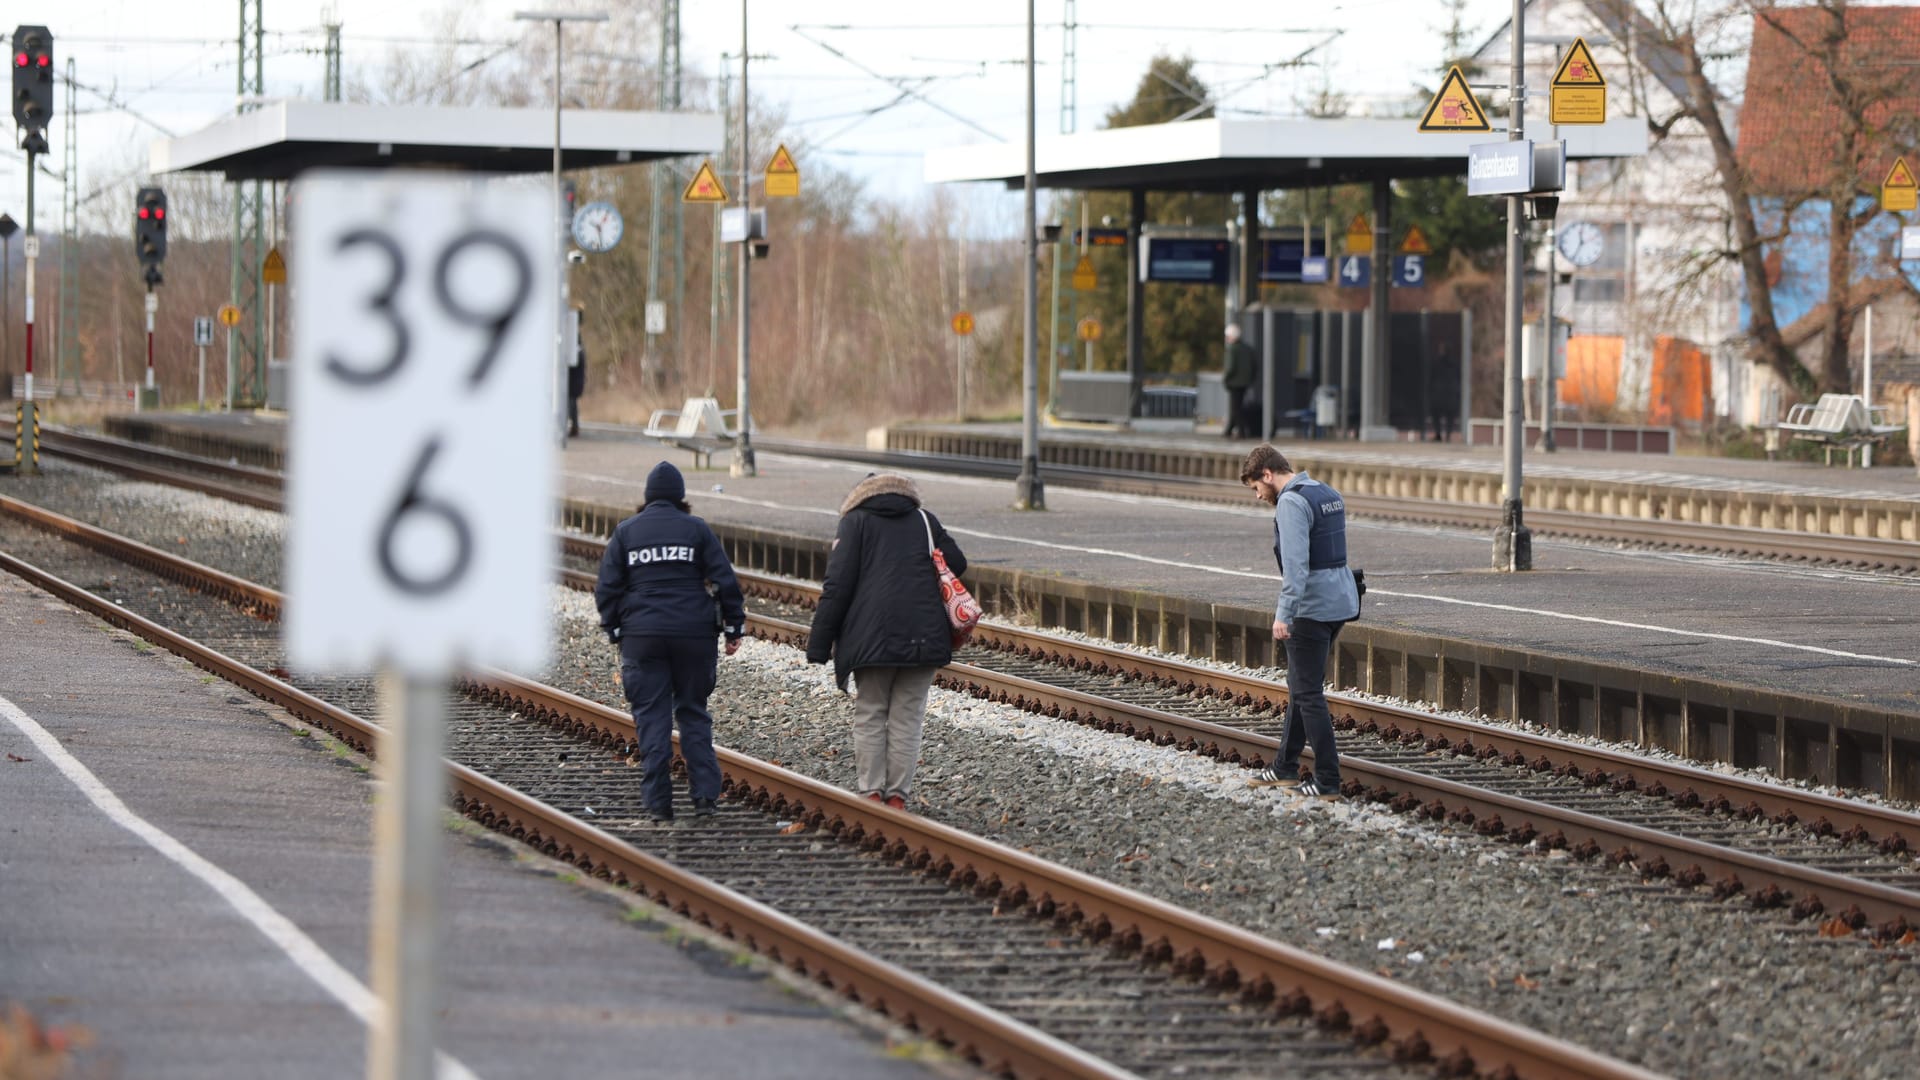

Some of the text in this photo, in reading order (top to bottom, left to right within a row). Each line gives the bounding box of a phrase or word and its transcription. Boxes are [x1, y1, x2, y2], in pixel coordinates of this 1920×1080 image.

[1342, 255, 1360, 282] 4
[1403, 255, 1422, 282] 5
[322, 226, 534, 390] 39
[376, 432, 474, 596] 6
[628, 546, 694, 566] POLIZEI
